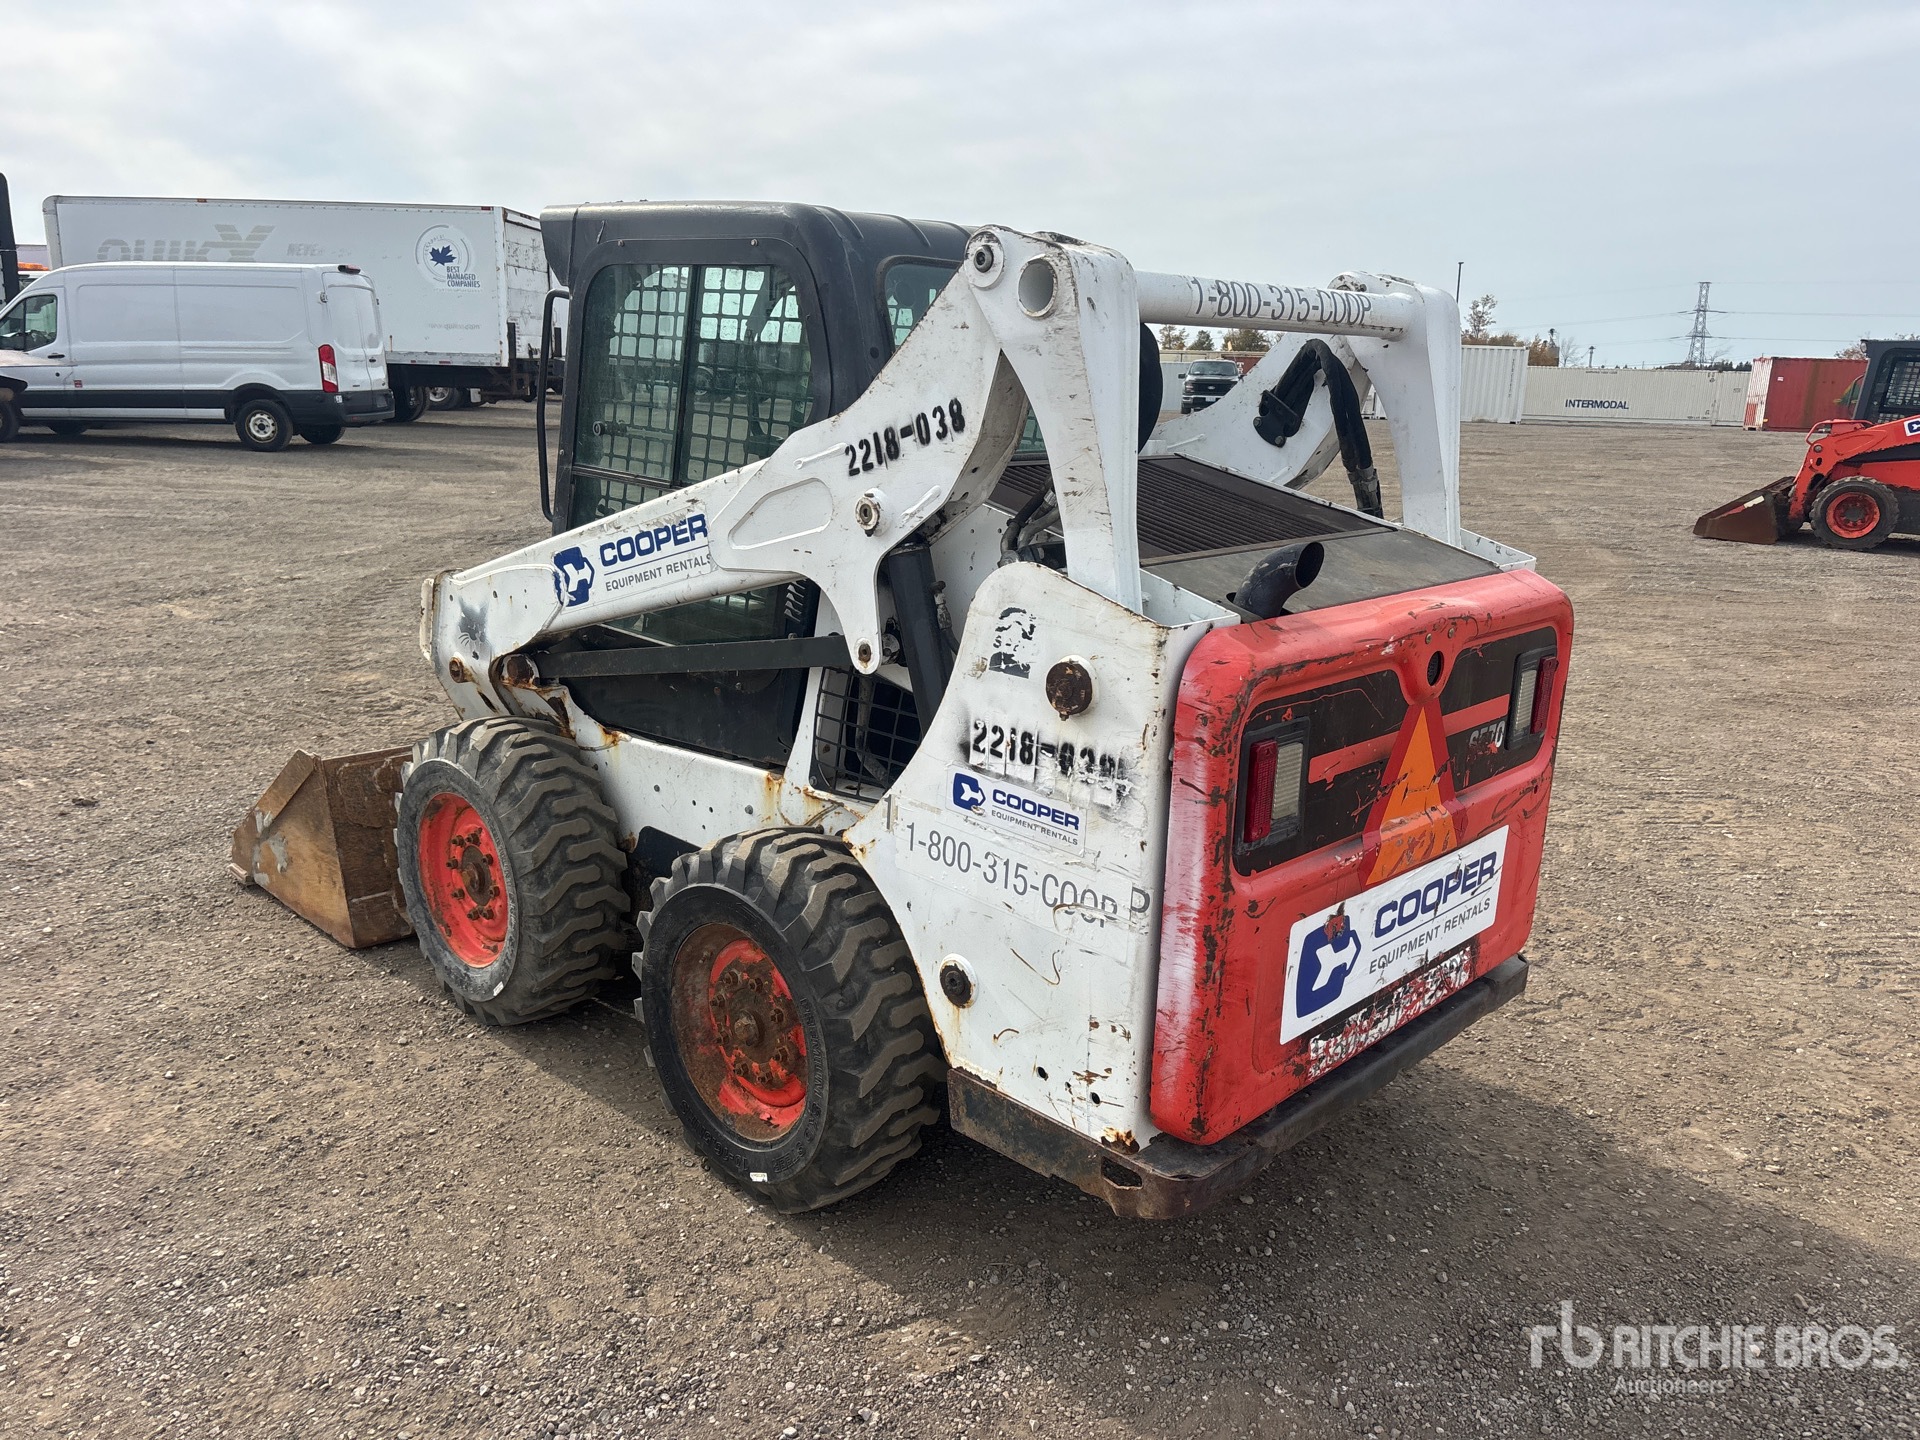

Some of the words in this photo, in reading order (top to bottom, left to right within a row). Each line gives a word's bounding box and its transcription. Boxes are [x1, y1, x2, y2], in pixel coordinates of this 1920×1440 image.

[446, 265, 460, 273] BEST
[446, 273, 476, 281] MANAGED
[447, 280, 481, 288] COMPANIES
[1191, 276, 1372, 325] 1-800-315-COOP
[1565, 399, 1629, 410] INTERMODAL
[845, 397, 966, 477] 2218-038
[600, 513, 708, 567] COOPER
[605, 567, 663, 591] EQUIPMENT
[666, 553, 712, 574] RENTALS
[991, 809, 1040, 831] EQUIPMENT
[1040, 827, 1079, 846] RENTALS
[992, 788, 1080, 831] COOPER
[1374, 851, 1497, 938] COOPER
[1369, 924, 1441, 974] EQUIPMENT
[1444, 897, 1490, 933] RENTALS
